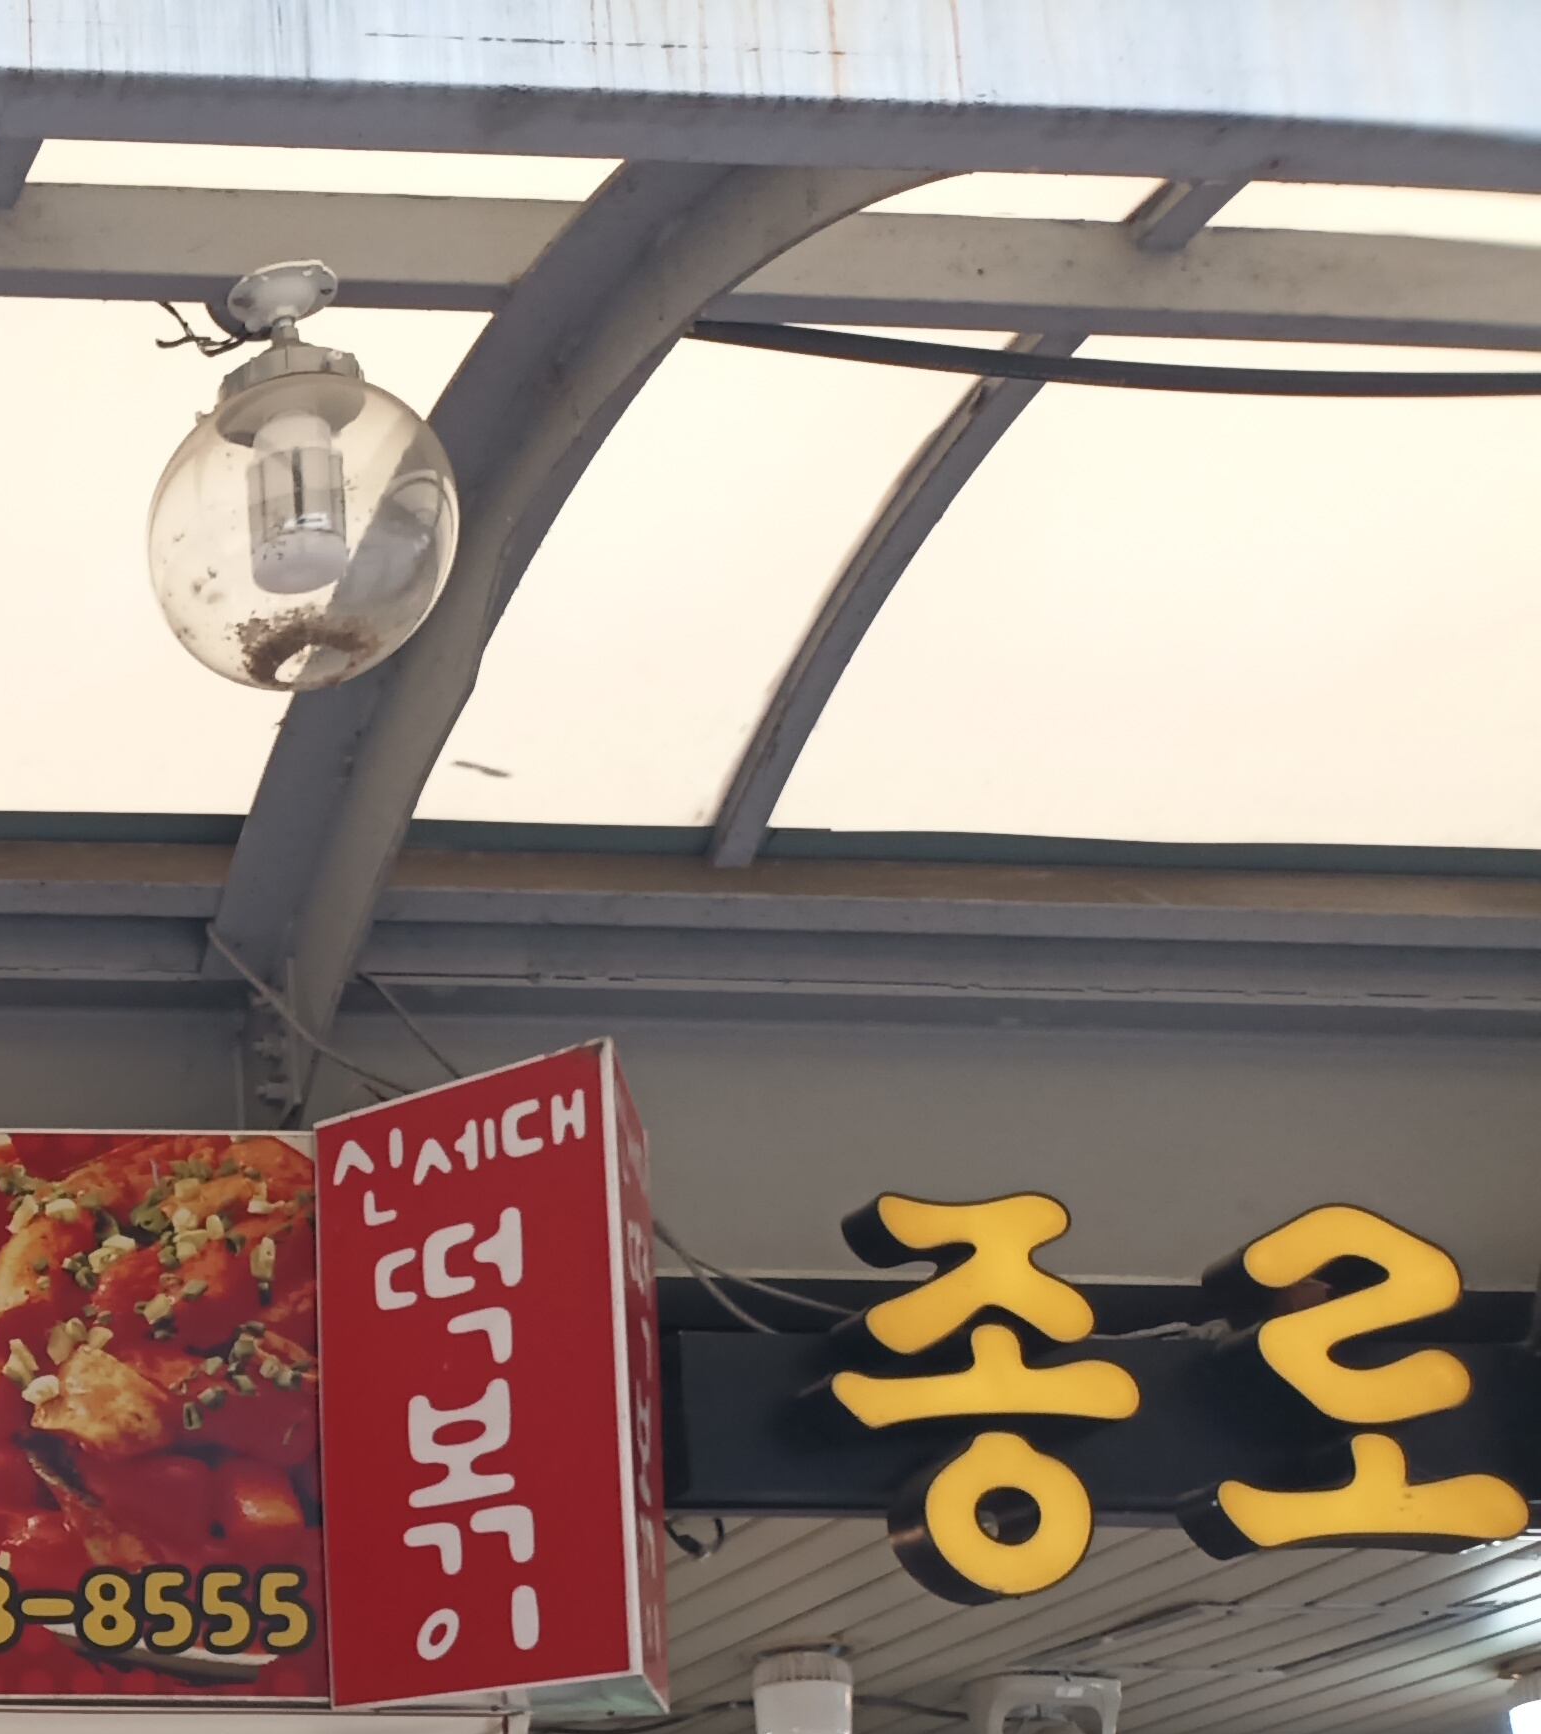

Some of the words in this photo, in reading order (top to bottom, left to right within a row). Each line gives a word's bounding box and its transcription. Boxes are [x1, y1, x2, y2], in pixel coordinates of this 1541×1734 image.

[333, 1089, 586, 1226] 신세대
[374, 1207, 539, 1661] 떡볶이
[831, 1191, 1528, 1594] 종로
